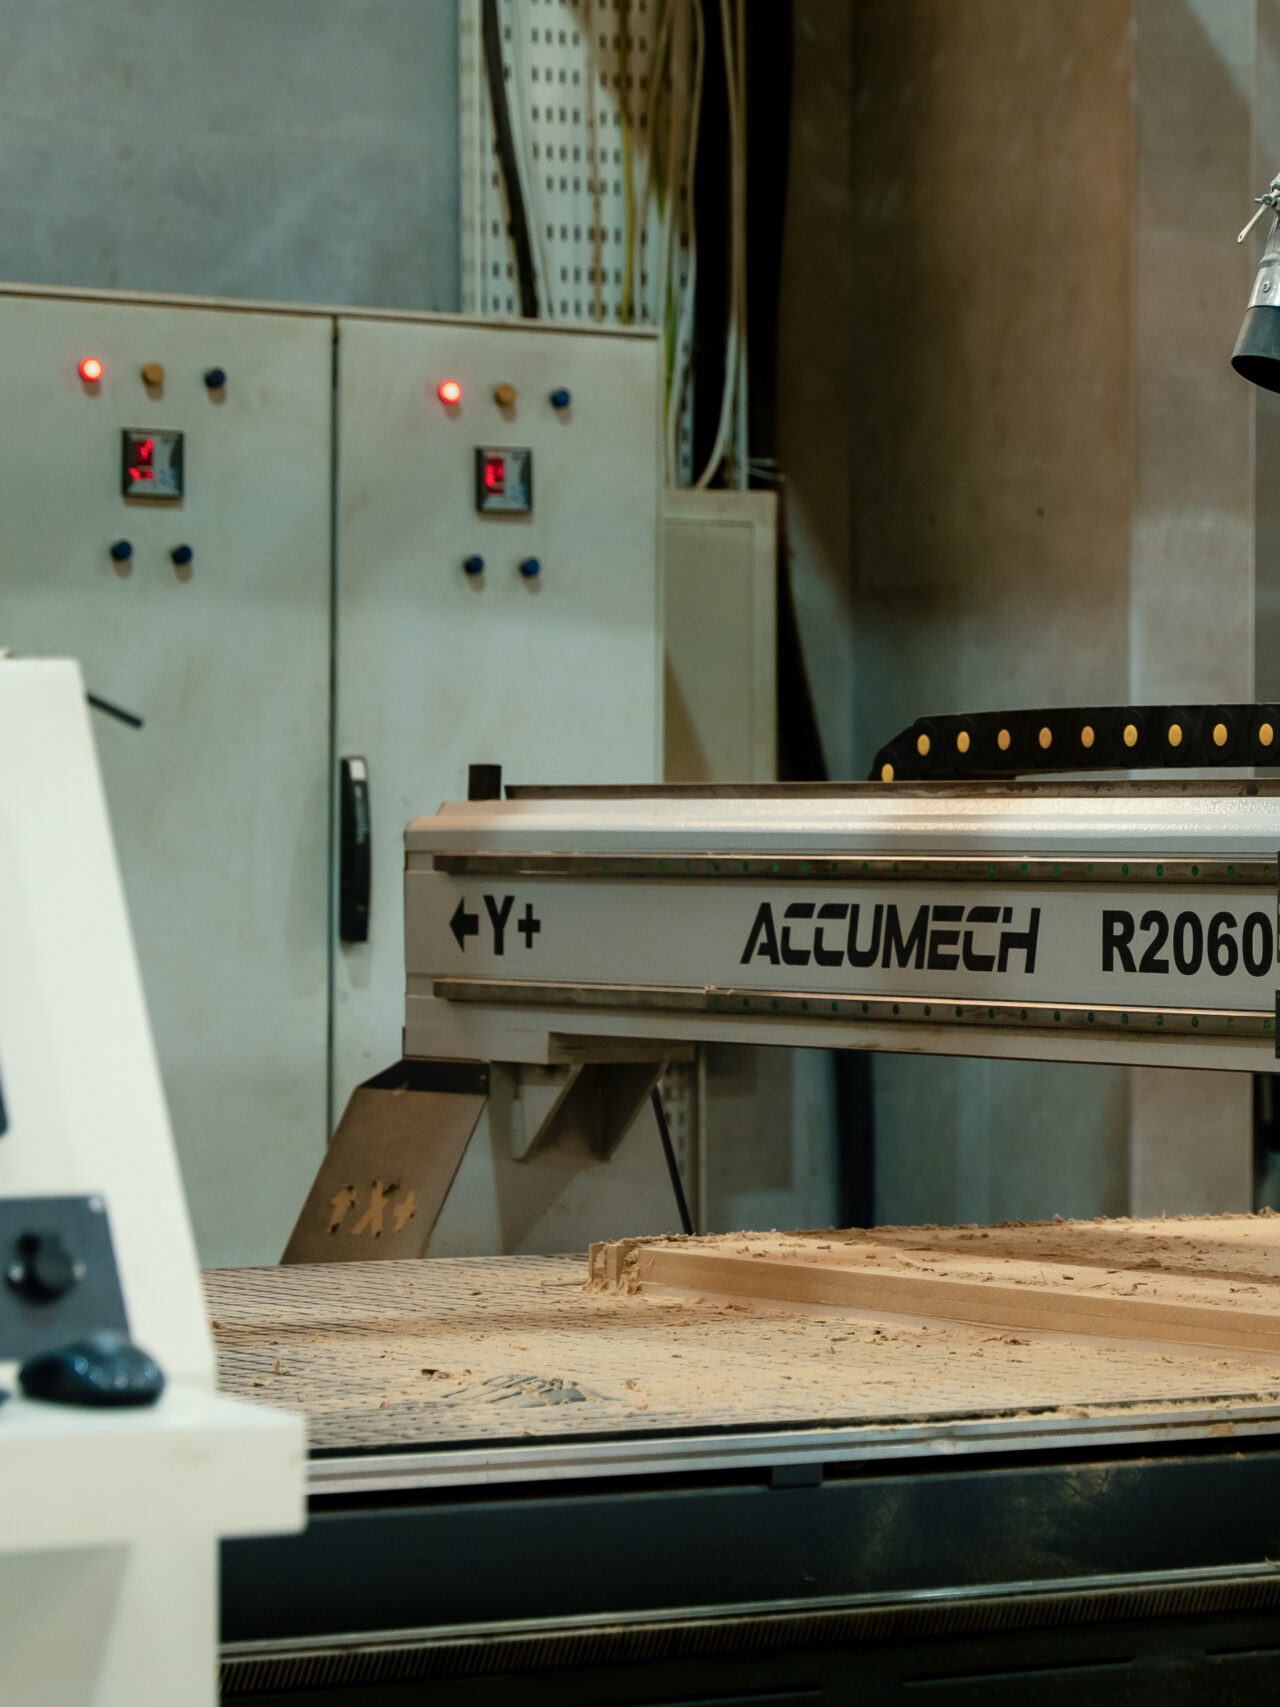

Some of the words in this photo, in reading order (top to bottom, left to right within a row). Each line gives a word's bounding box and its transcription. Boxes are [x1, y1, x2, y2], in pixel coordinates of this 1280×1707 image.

[483, 894, 541, 956] Y+
[740, 902, 1041, 974] ACCUMECH
[1102, 909, 1274, 977] R2060
